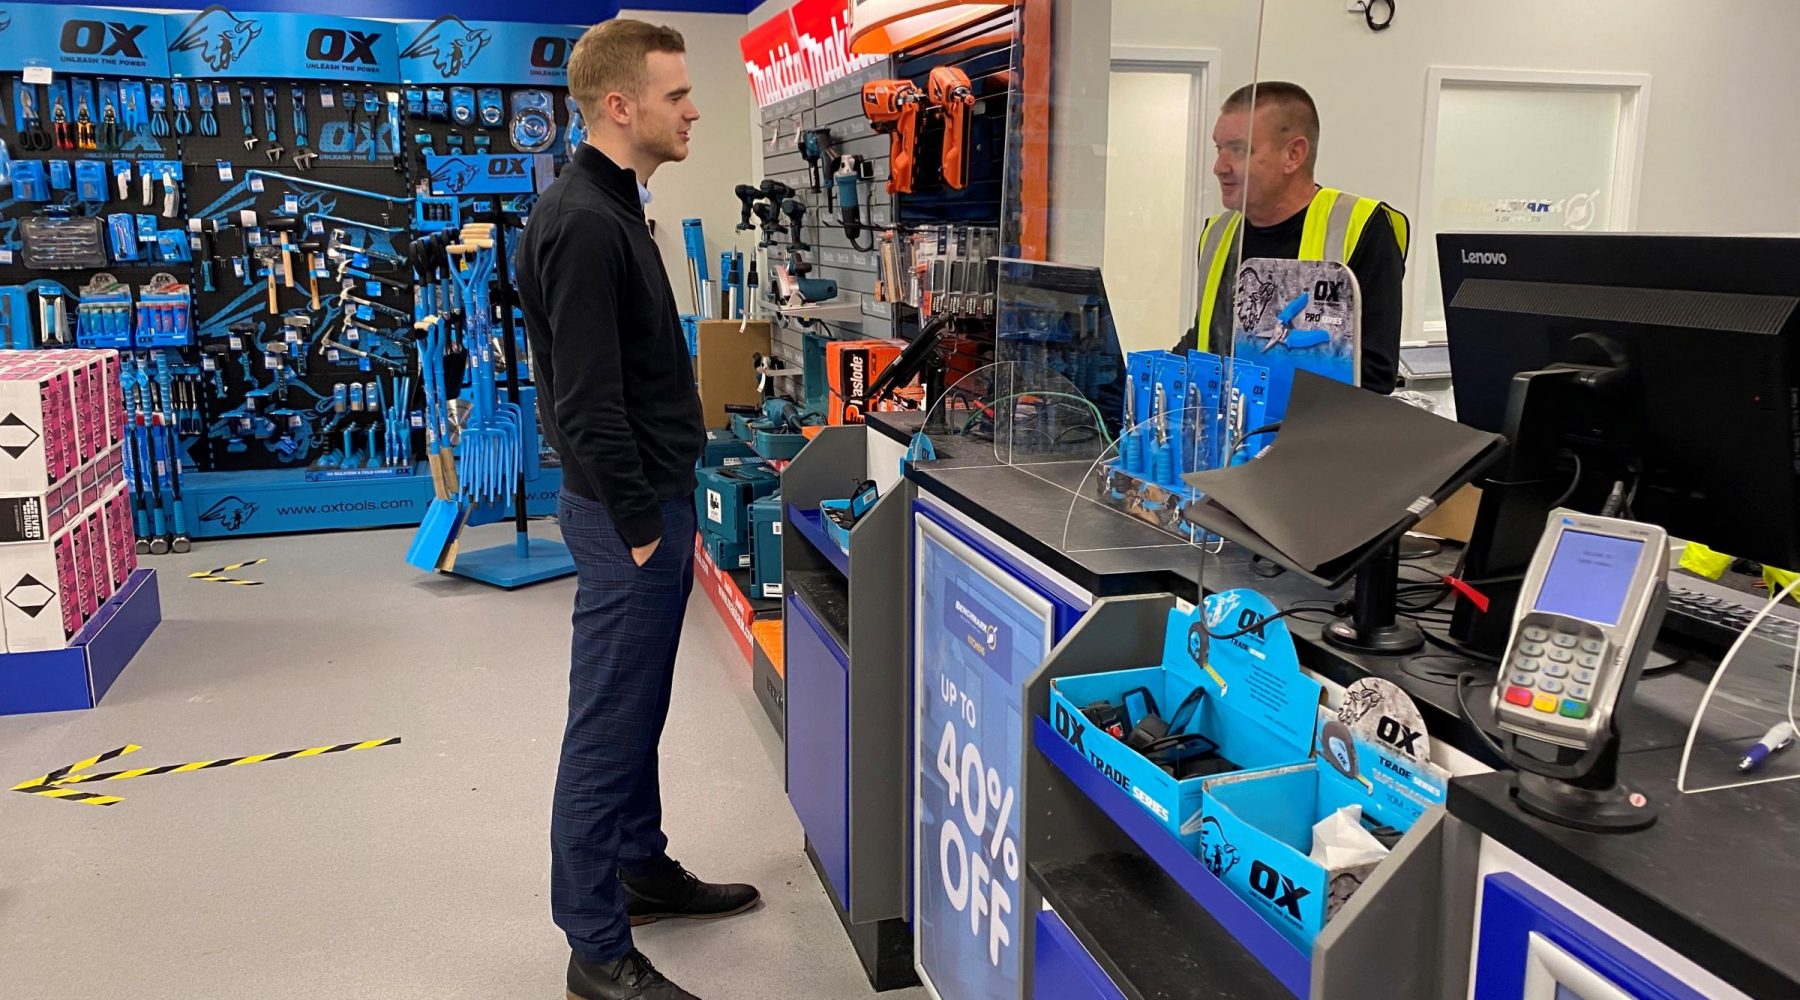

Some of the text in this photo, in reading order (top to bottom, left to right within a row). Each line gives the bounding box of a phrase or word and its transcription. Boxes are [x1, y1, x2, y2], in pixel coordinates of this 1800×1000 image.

[60, 19, 148, 58] OX
[306, 28, 382, 64] OX
[60, 56, 99, 65] UNLEASH
[119, 58, 147, 67] POWER
[306, 63, 339, 71] UNLEASH
[488, 157, 527, 175] OX
[1461, 249, 1507, 265] Lenovo
[1313, 280, 1344, 302] OX
[1305, 312, 1321, 323] PRO
[277, 499, 413, 515] www.oxtools.com
[23, 515, 33, 538] BUILD
[31, 515, 40, 538] EVER
[1238, 608, 1265, 640] OX
[941, 673, 976, 728] UP TO
[1377, 715, 1422, 757] OX
[1056, 702, 1169, 822] OX TRADE SERIES
[1379, 756, 1412, 780] TRADE
[937, 721, 1019, 881] 40%
[940, 819, 1011, 967] OFF
[1249, 859, 1312, 921] OX
